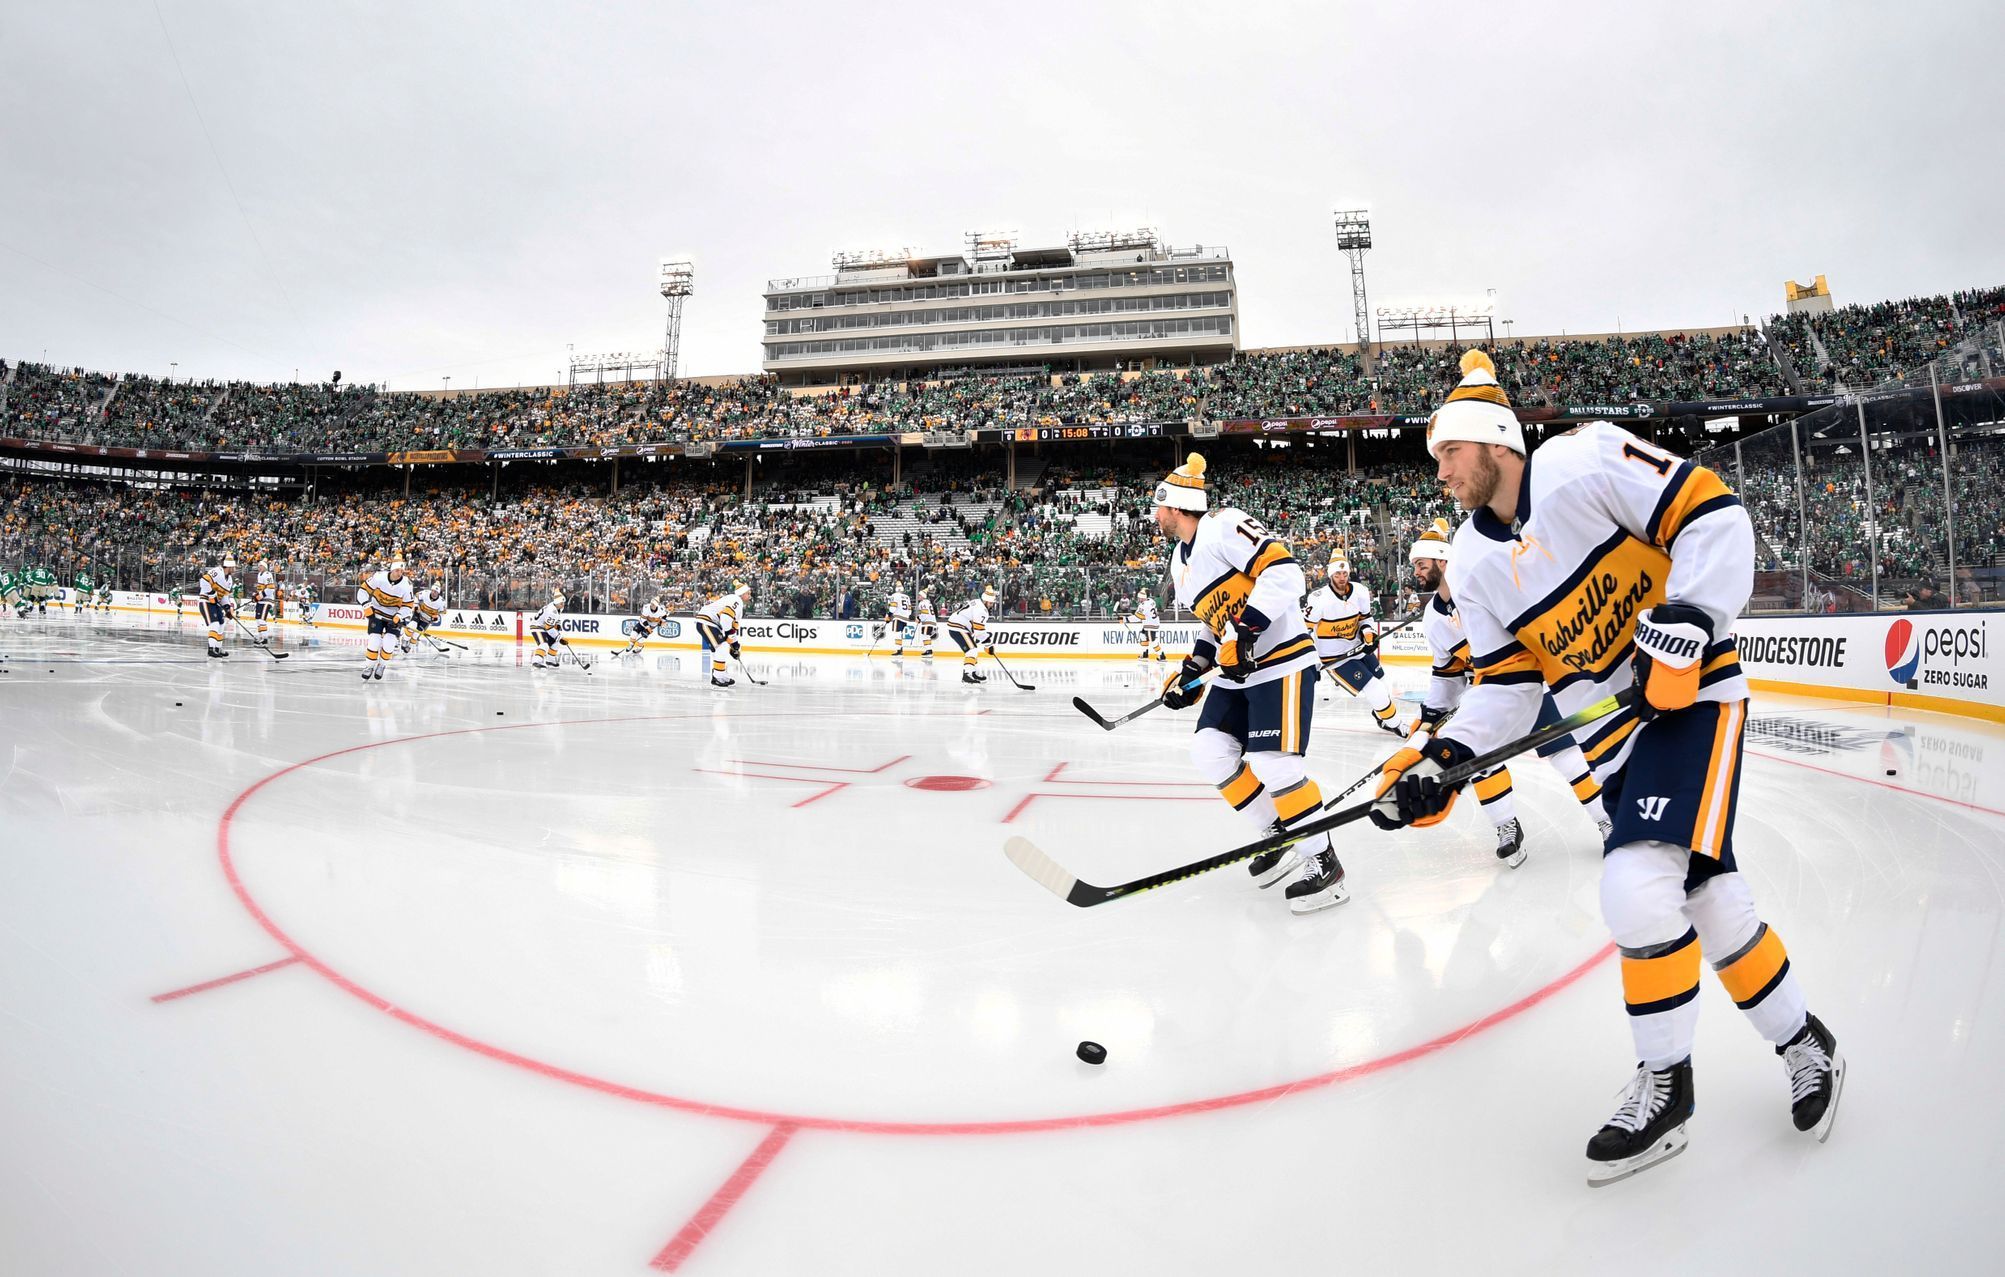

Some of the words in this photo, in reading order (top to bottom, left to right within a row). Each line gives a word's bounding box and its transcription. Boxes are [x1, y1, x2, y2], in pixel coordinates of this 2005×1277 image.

[1953, 384, 1983, 392] DISCOVER
[1595, 407, 1630, 415] STARS
[1708, 403, 1763, 411] #WINTERCLASSIC
[1042, 429, 1048, 439] 0
[1062, 428, 1088, 438] 15:08
[1114, 426, 1121, 436] 0
[560, 619, 600, 633] GNER
[735, 625, 772, 638] reat
[777, 623, 818, 642] Clips
[846, 626, 863, 638] PPG
[903, 626, 916, 639] PG
[984, 632, 1081, 645] IDGESTONE
[1103, 630, 1124, 644] NEW
[1126, 630, 1189, 644] AMERDAM
[1633, 619, 1701, 659] ARRIOR
[1924, 619, 1986, 667] pepsi
[1924, 669, 1951, 686] ZERO
[1952, 671, 1988, 690] SUGAR
